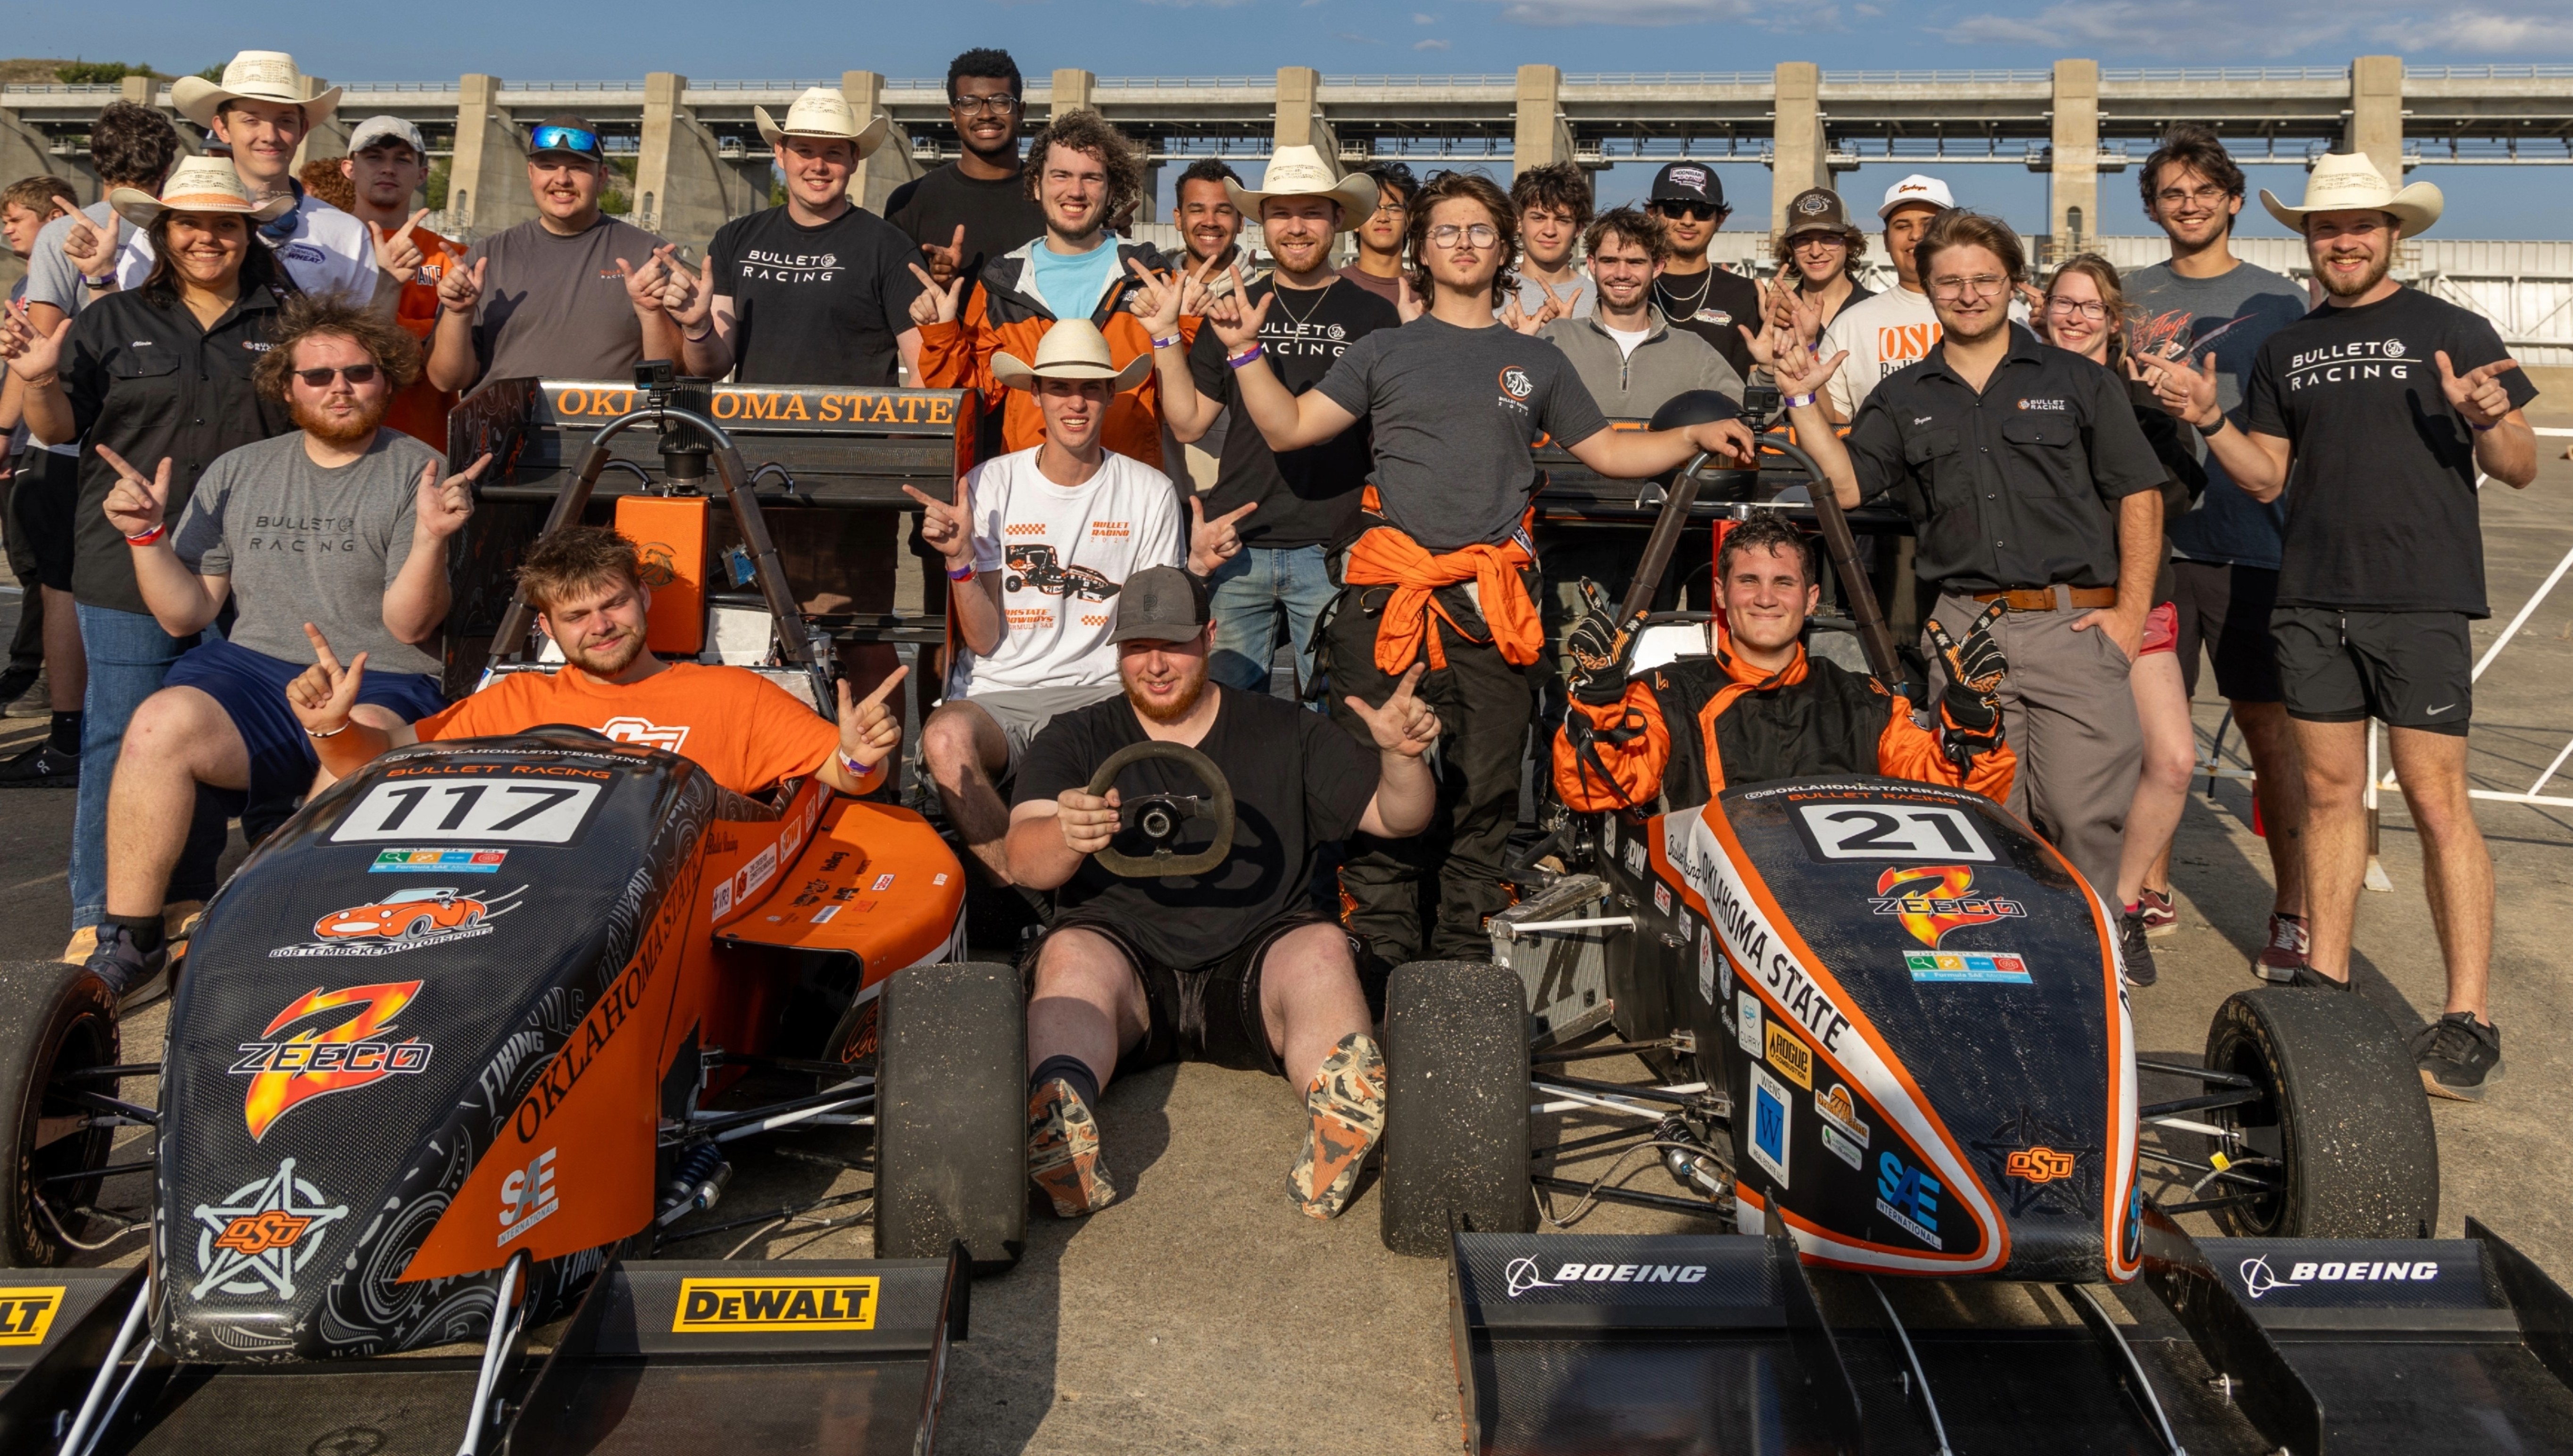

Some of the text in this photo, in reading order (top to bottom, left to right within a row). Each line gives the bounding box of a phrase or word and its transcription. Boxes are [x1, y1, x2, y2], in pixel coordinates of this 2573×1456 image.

[1797, 194, 1832, 207] CATERPILLAR
[289, 252, 320, 263] WHEAT
[748, 250, 820, 266] BULLET
[742, 266, 833, 283] RACING
[1261, 342, 1345, 357] ACING
[2292, 342, 2381, 368] BULLET
[2291, 365, 2407, 391] RACING
[558, 389, 954, 424] OKLOMA STATE
[256, 516, 336, 531] BULLET
[250, 538, 354, 553] RACNG
[413, 749, 647, 765] @OKLAHOMASTATERACING
[386, 765, 611, 780] BULLET RACING
[377, 785, 580, 832] 117
[1762, 784, 1984, 804] @OKLAHOMASTATERACING
[1788, 792, 1958, 805] BULLET RACING
[1824, 810, 1975, 853] 21
[819, 850, 850, 872] Holley
[1628, 837, 1647, 873] DW
[719, 887, 730, 910] VR3
[1868, 898, 2027, 918] ZEECO
[271, 927, 494, 957] BOB LEMBCKE MOTORSPORTS
[1702, 852, 1850, 1054] OKLAHOMA STATE
[516, 926, 664, 1145] OKLAHOMA
[663, 849, 700, 944] STATE
[1740, 1032, 1761, 1051] CURRY
[1776, 1033, 1808, 1073] ROGUE
[228, 1042, 433, 1073] ZEECO
[1775, 1053, 1807, 1082] COMBUSTION
[479, 1031, 544, 1117] FIRING
[1761, 1073, 1781, 1100] WIENS
[1759, 1100, 1782, 1148] W
[1839, 1107, 1868, 1139] Plains
[1753, 1149, 1784, 1183] REAL ESTATE LLC
[2006, 1147, 2074, 1183] OSU
[499, 1146, 557, 1226] SAE
[1878, 1151, 1940, 1232] SAE
[214, 1210, 313, 1256] OSU
[498, 1204, 555, 1246] INTERNATIONAL
[1877, 1199, 1936, 1246] INTERNATIONAL
[1554, 1264, 1707, 1282] BOEING
[2289, 1262, 2438, 1281] BOEING
[684, 1290, 870, 1320] DEWALT
